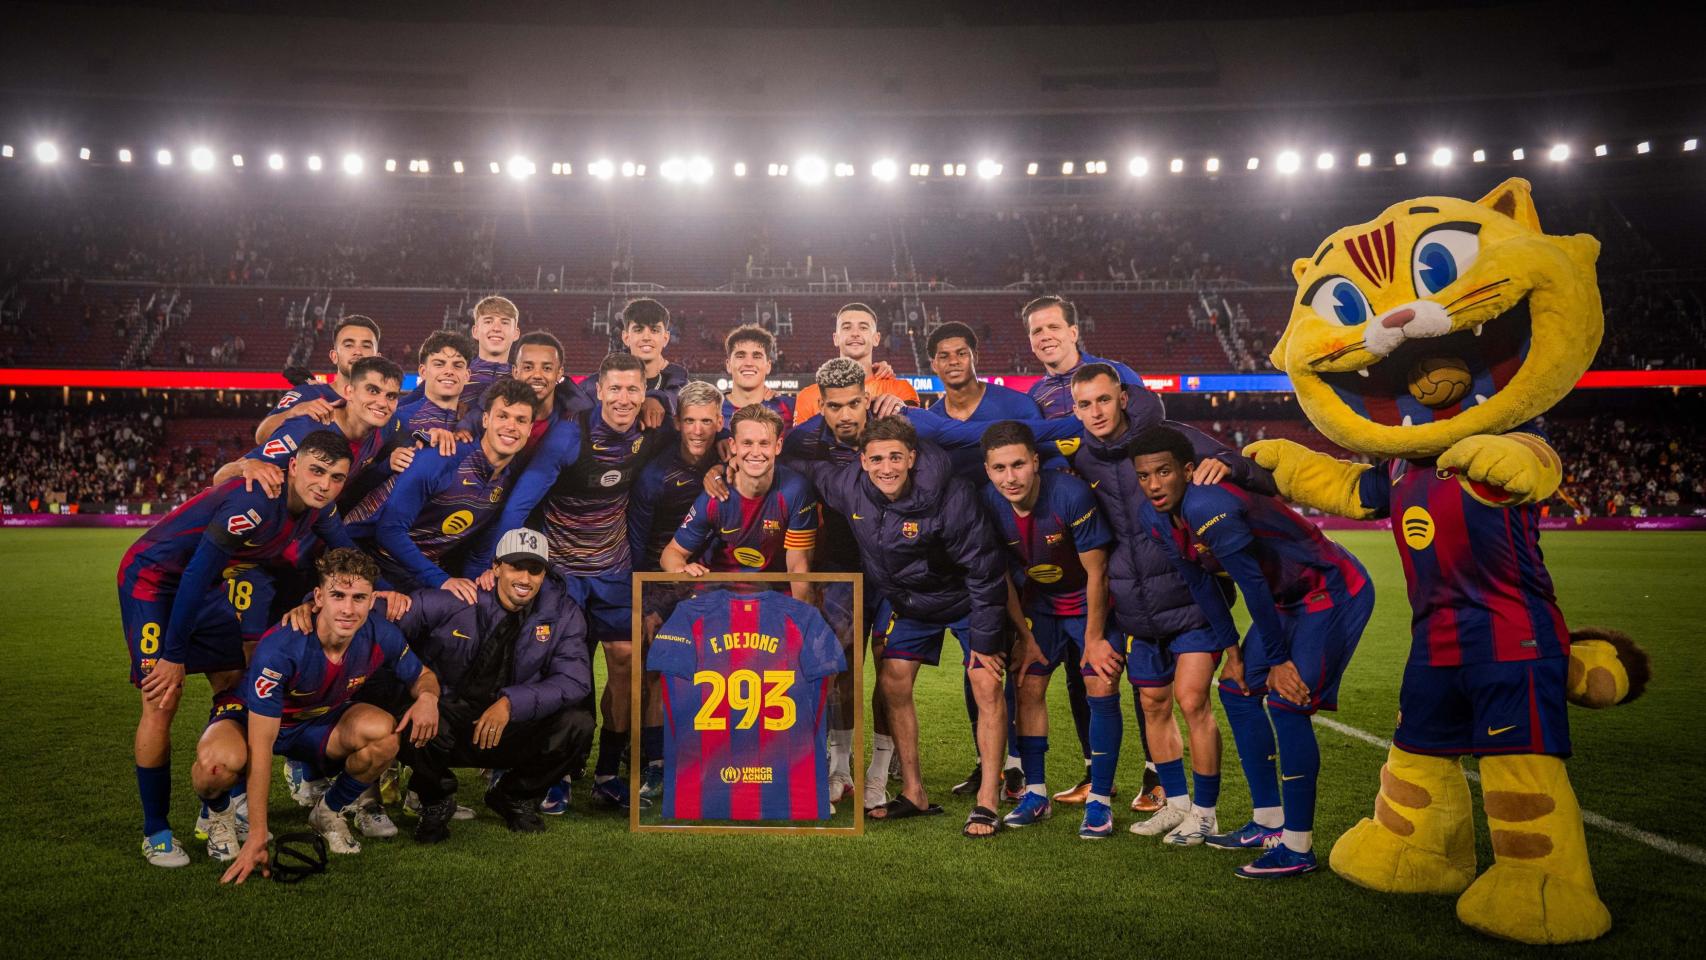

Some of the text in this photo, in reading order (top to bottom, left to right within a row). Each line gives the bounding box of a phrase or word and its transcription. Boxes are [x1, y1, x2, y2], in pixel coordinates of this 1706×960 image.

[781, 380, 799, 389] NOU
[518, 532, 538, 550] Y-3
[227, 578, 253, 610] 18
[140, 622, 161, 655] 8
[655, 633, 686, 643] AMBILIGHT
[710, 632, 779, 654] F. DE JONG
[693, 669, 797, 731] 293
[742, 766, 773, 774] UNHCR
[742, 773, 773, 781] ACNUR
